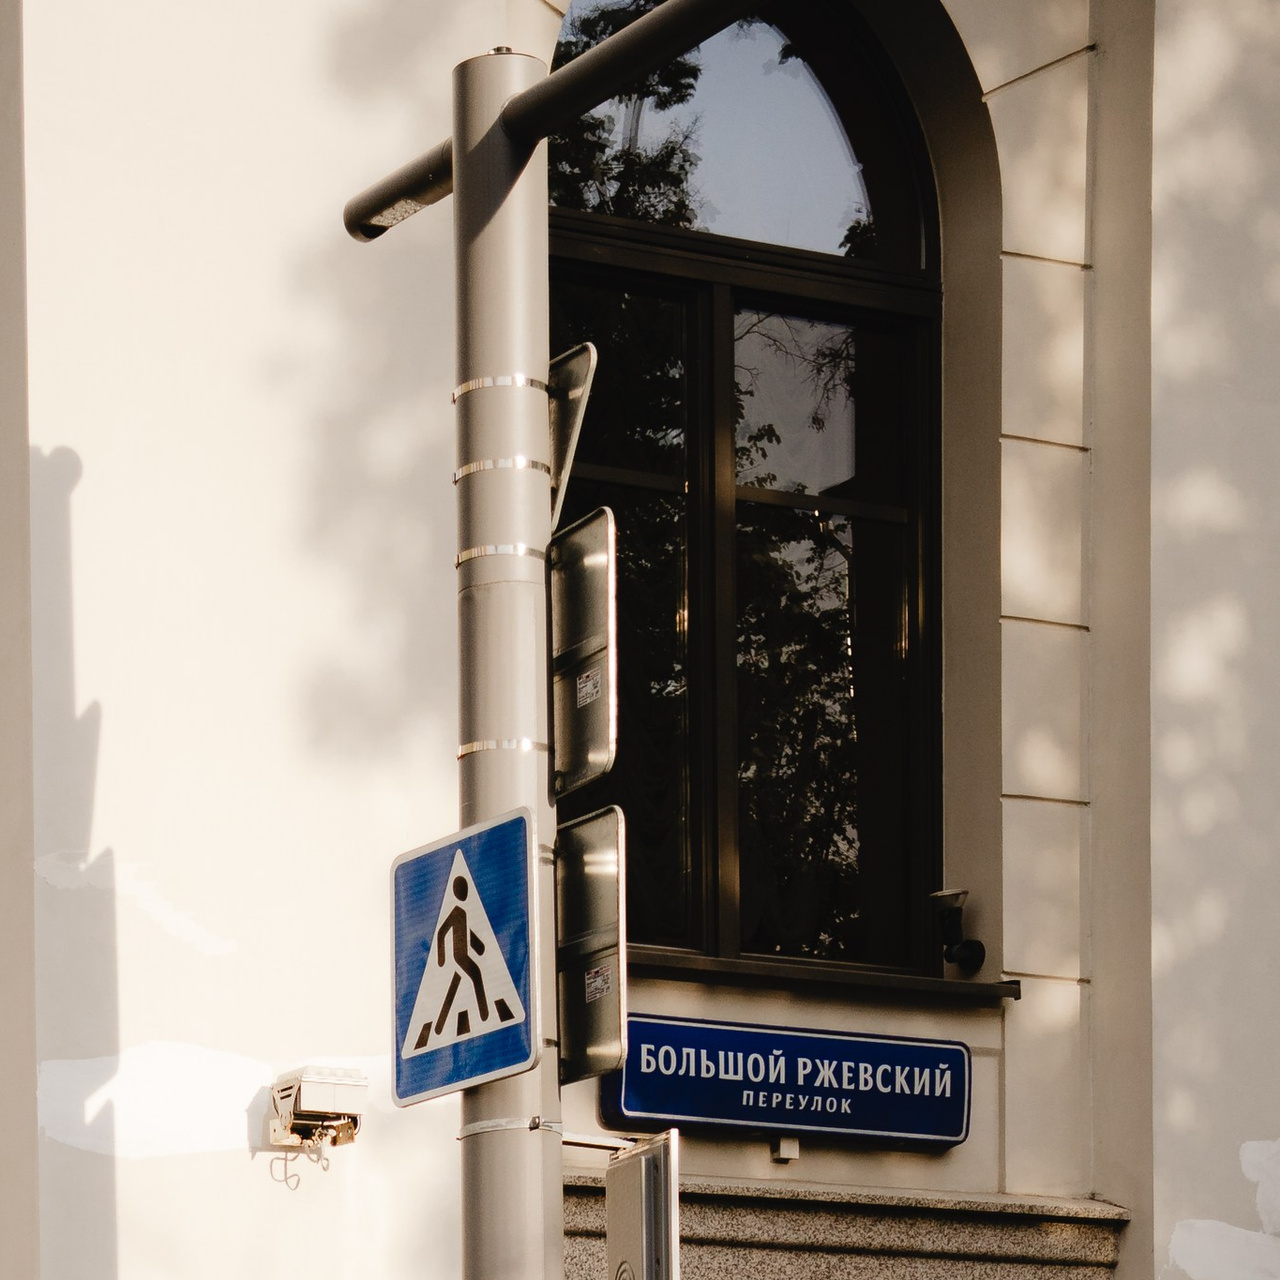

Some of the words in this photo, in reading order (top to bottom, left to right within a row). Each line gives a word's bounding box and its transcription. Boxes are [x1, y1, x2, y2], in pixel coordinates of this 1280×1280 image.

[640, 1043, 786, 1085] БОЛЬШОЙ
[797, 1057, 953, 1097] РЖЕВСКИЙ
[741, 1090, 852, 1115] ПЕРЕУЛОК
